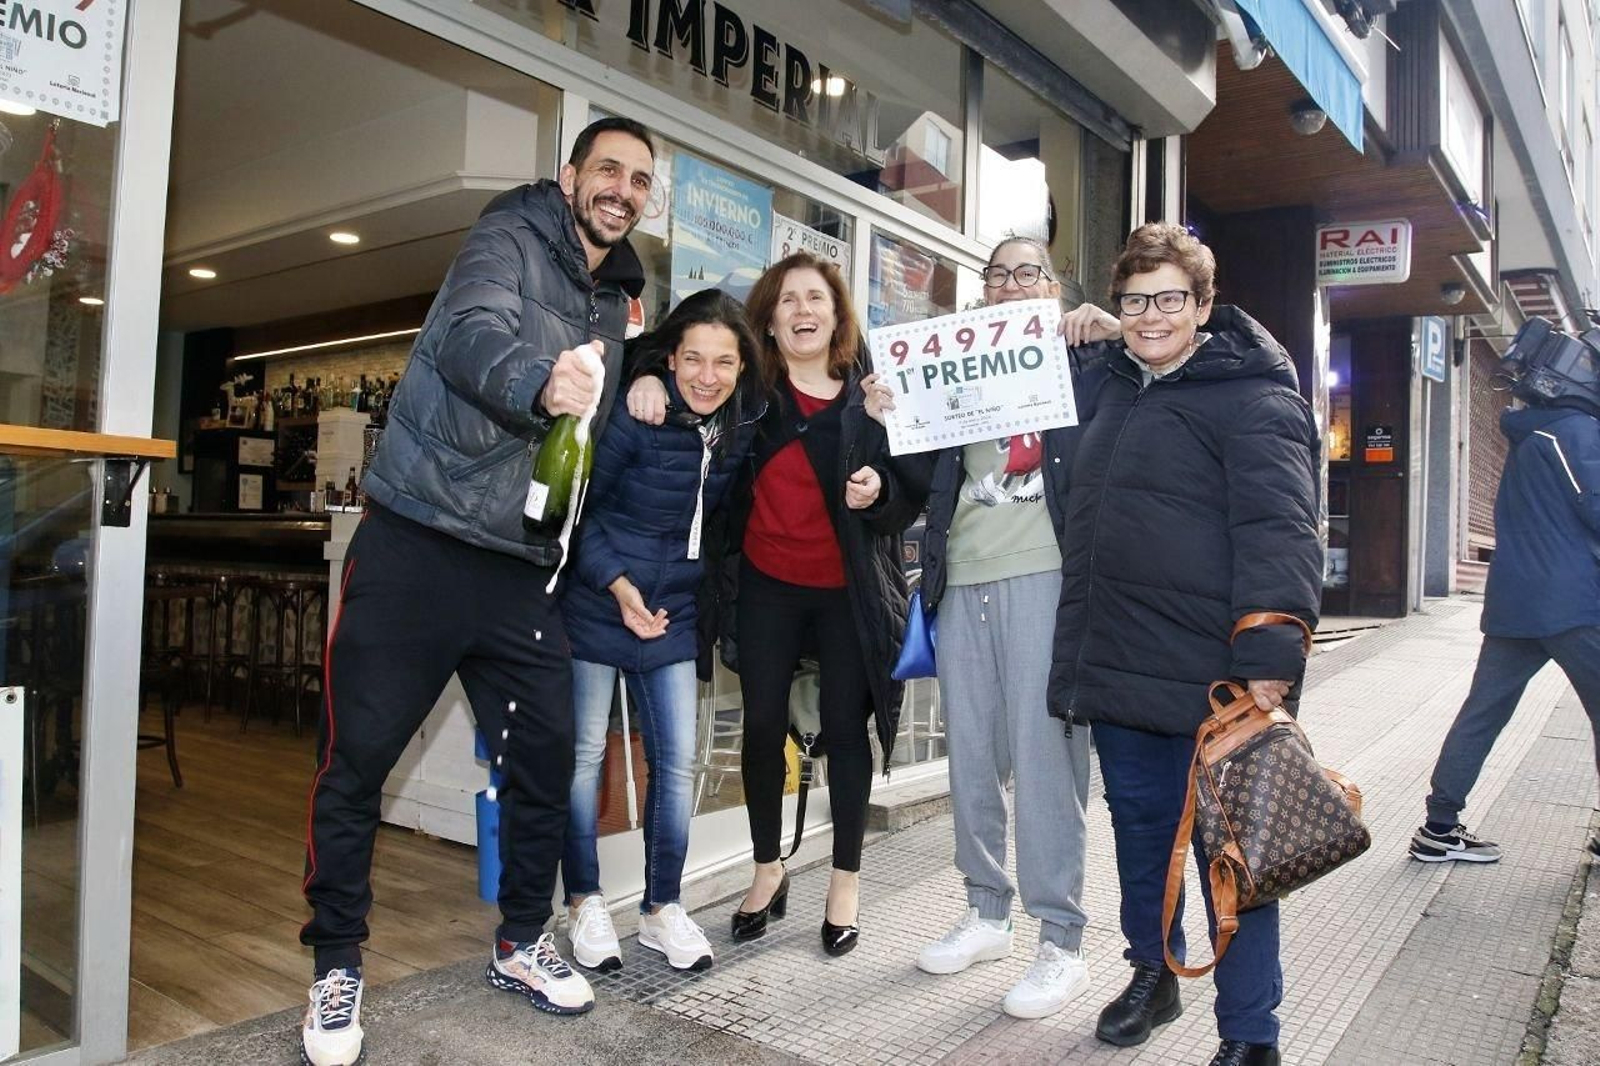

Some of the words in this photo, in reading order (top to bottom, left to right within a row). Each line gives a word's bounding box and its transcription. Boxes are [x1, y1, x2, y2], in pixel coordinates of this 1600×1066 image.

[626, 0, 886, 168] IMPERIAL
[687, 181, 761, 229] INVIERNO
[802, 231, 838, 258] PREMIO
[1320, 228, 1398, 250] RAI
[1320, 249, 1354, 258] MATERIAL
[922, 345, 1044, 389] PREMIO
